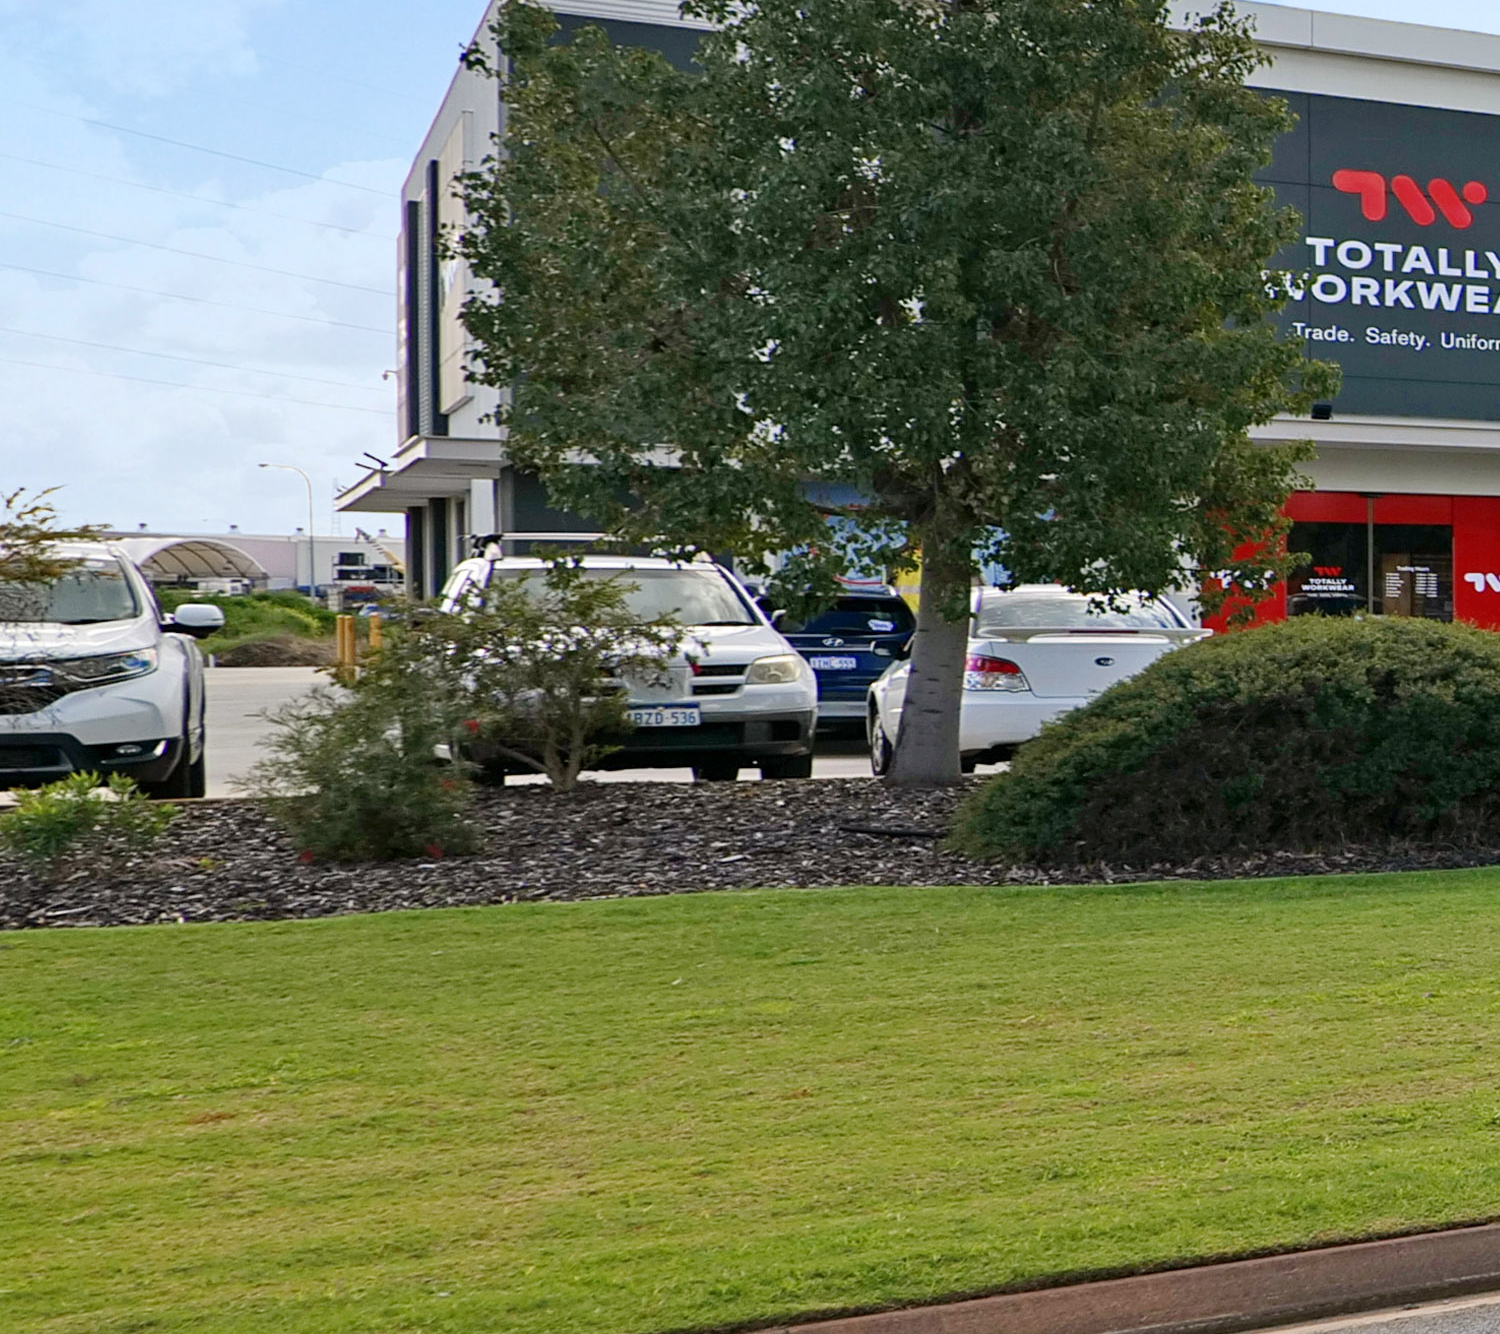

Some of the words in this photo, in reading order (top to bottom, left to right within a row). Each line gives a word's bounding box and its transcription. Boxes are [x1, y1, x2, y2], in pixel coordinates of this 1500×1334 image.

[1292, 322, 1355, 343] Trade.
[1365, 327, 1431, 351] Safety.
[1301, 584, 1355, 592] WORKWEAR
